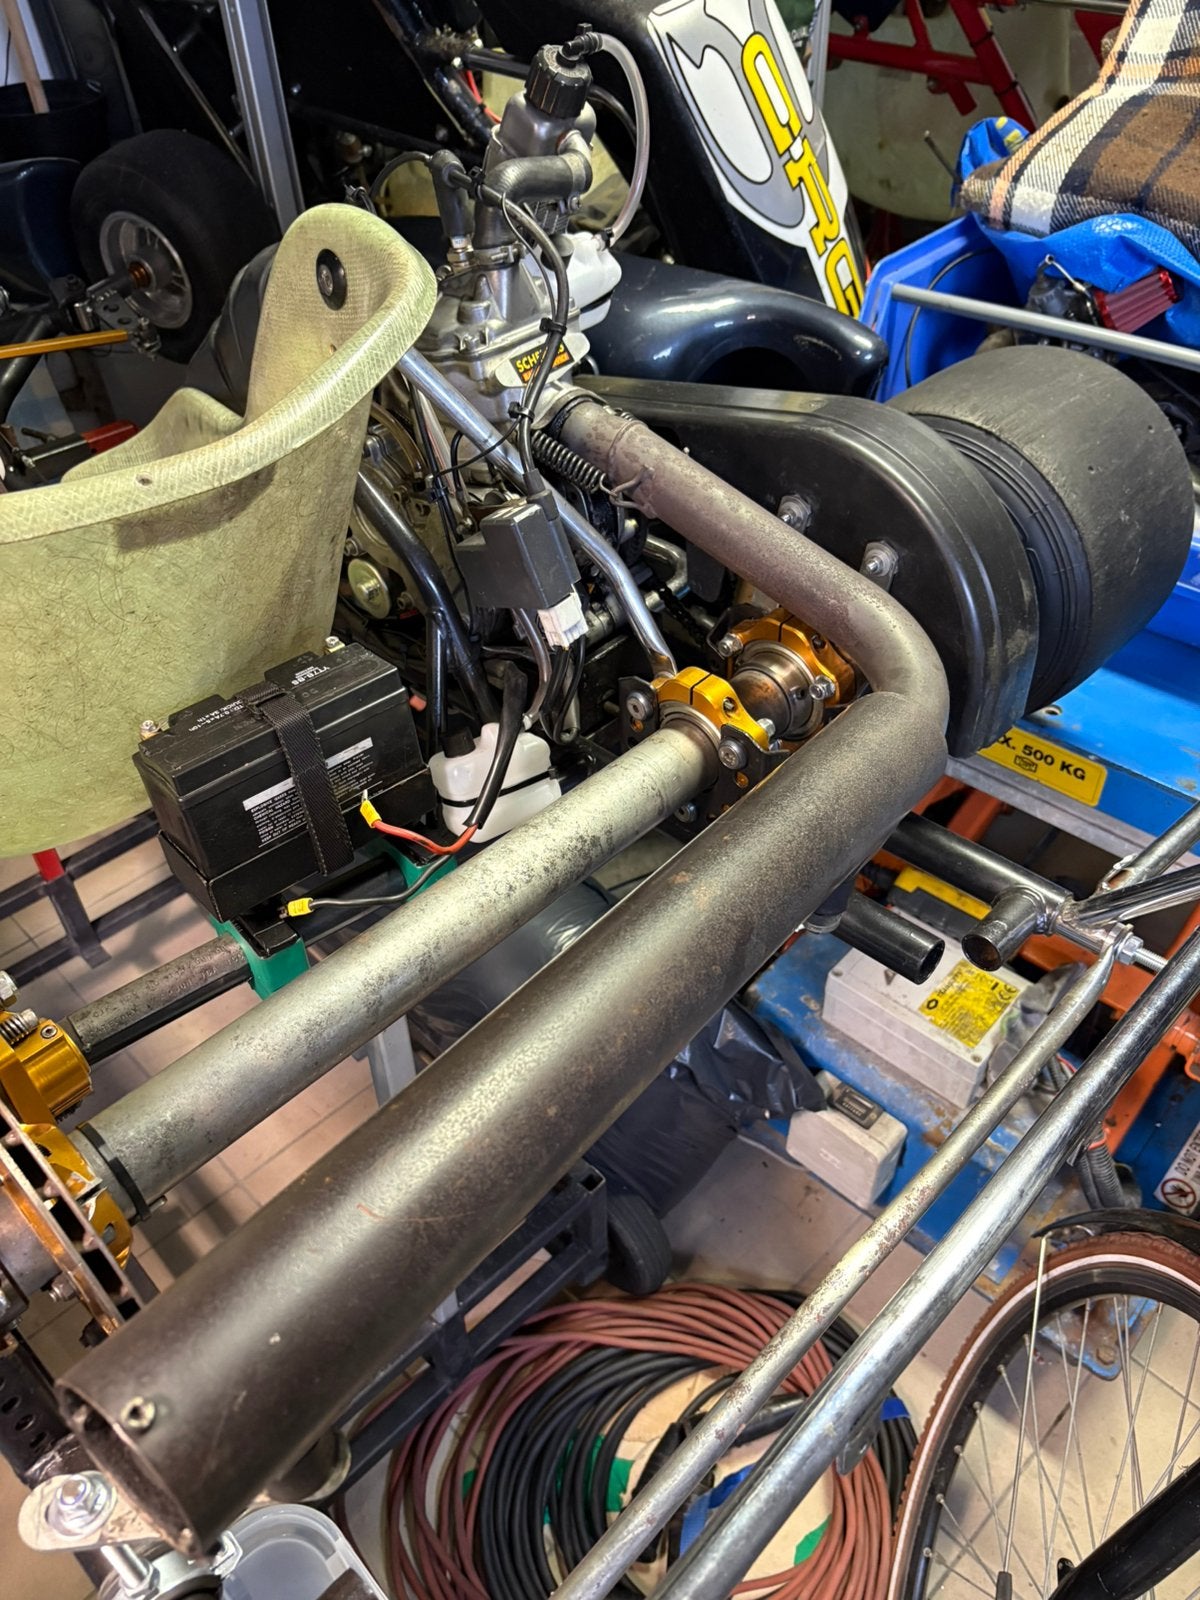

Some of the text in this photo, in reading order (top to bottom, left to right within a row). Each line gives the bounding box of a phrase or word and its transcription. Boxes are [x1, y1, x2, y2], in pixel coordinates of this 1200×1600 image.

[741, 31, 866, 319] CRG
[1021, 744, 1055, 767] 500
[1060, 761, 1086, 781] KG
